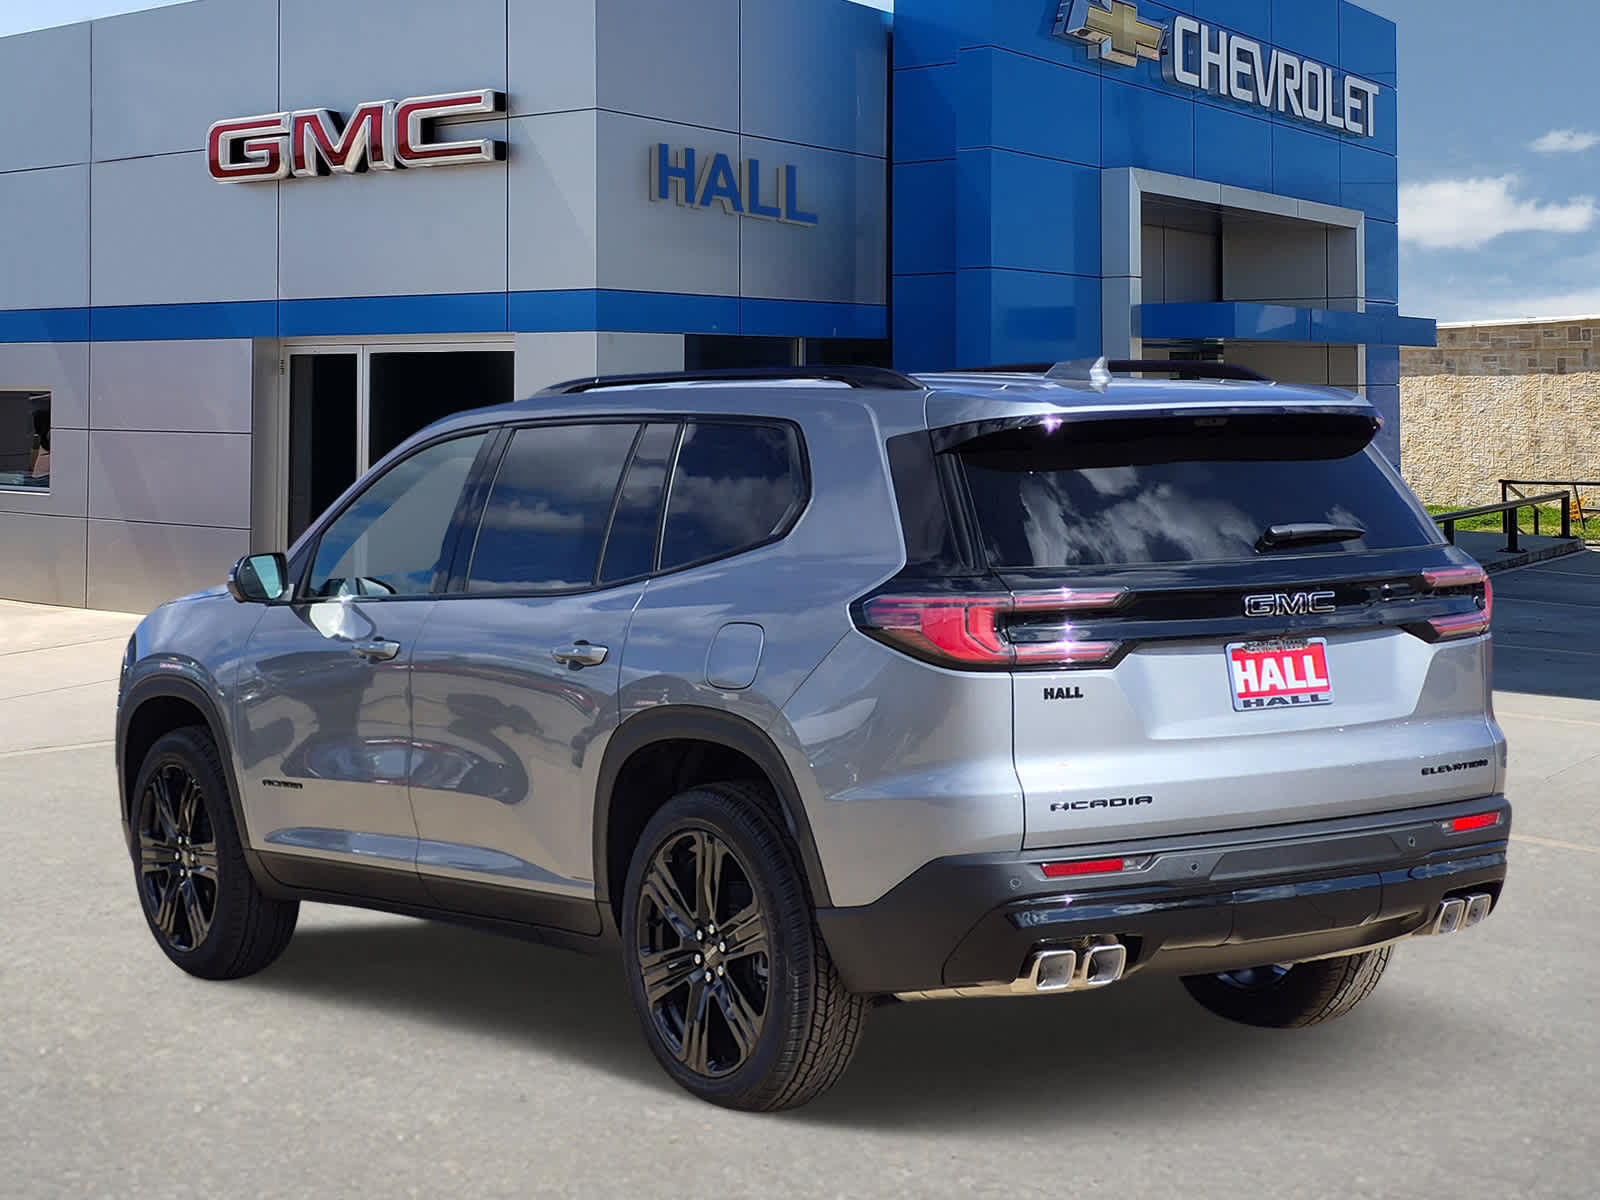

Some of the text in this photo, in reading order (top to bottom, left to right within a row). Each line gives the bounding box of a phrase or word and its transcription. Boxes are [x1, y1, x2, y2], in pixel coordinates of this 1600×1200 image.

[1173, 15, 1379, 137] CHEVROLET
[208, 88, 505, 184] GMC
[651, 143, 818, 227] HALL
[1244, 591, 1336, 617] GMC
[1231, 655, 1328, 693] HALL
[1043, 686, 1084, 700] HALL
[1242, 694, 1329, 708] HALL
[1421, 759, 1488, 775] ELEVATION
[1050, 795, 1153, 811] ACADIA
